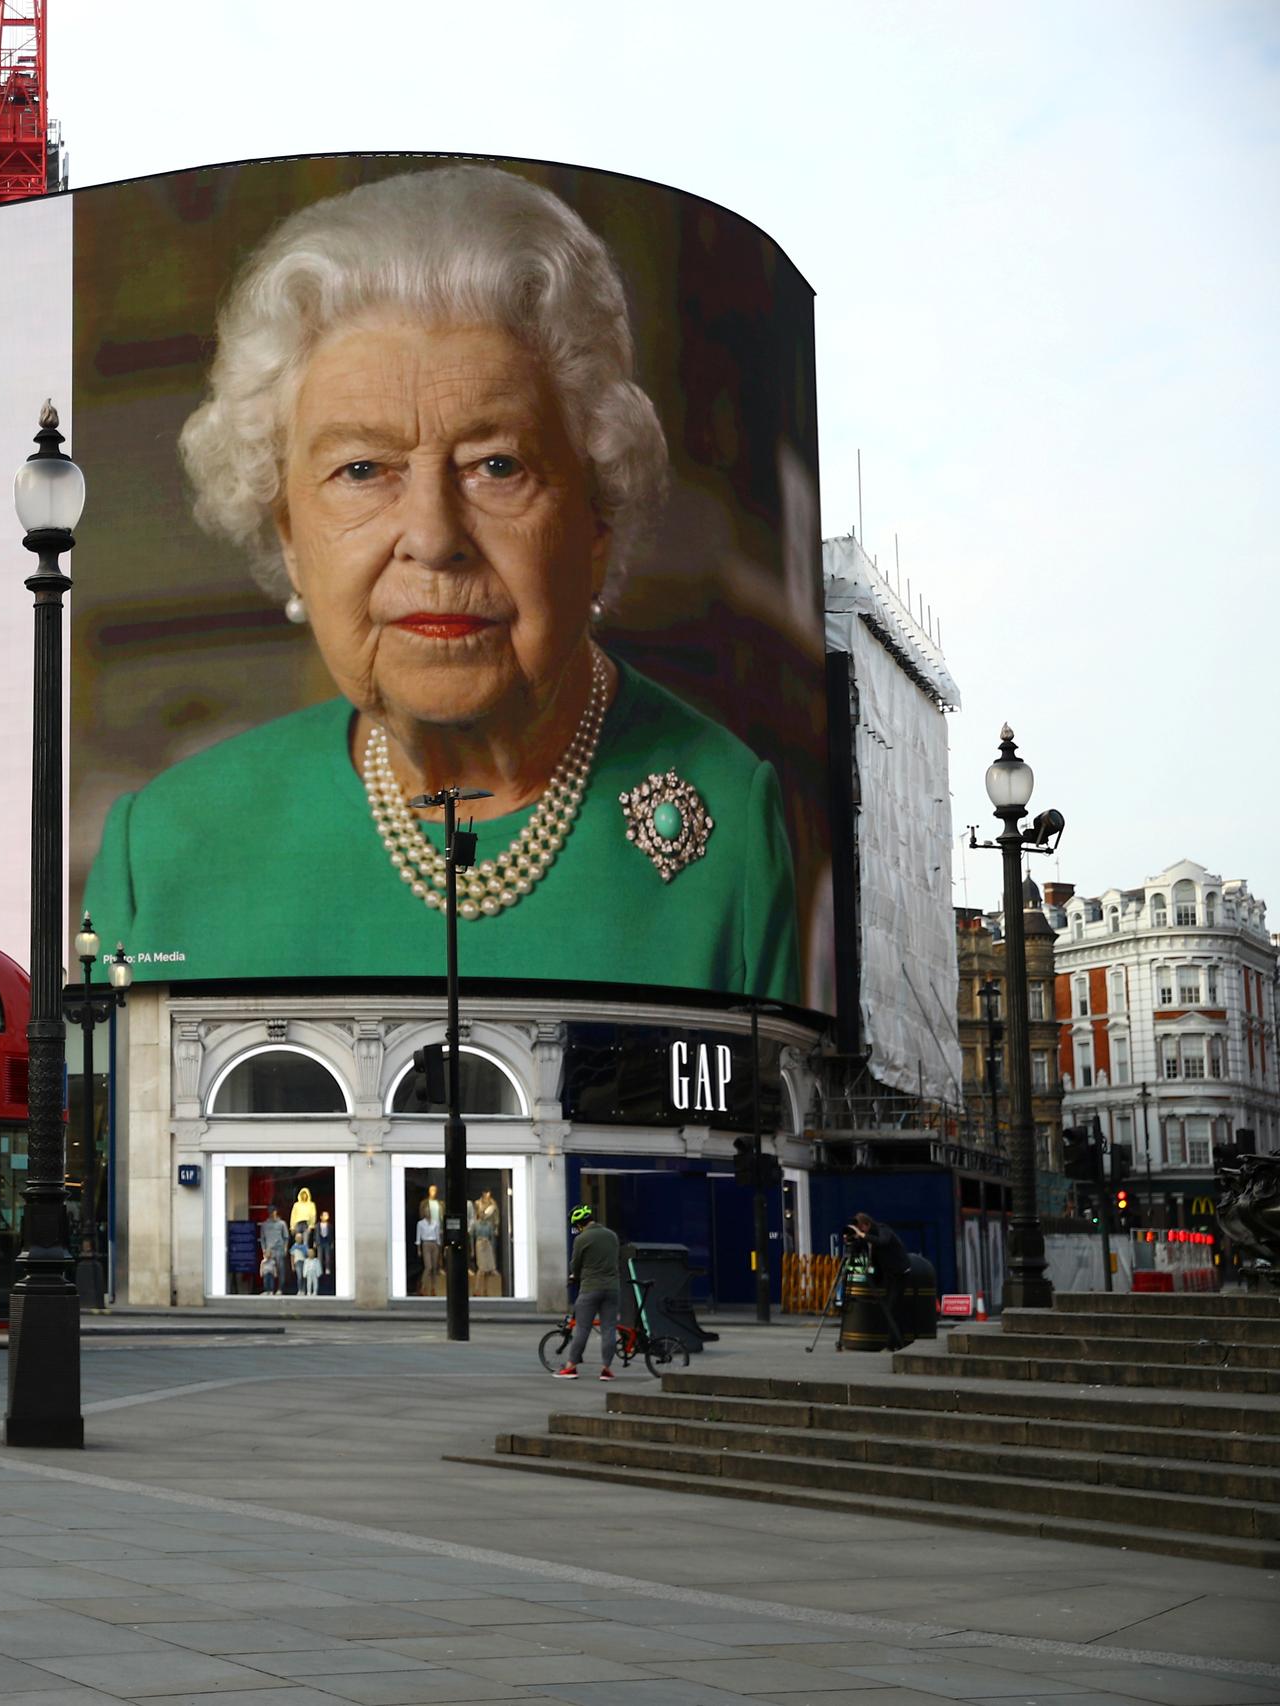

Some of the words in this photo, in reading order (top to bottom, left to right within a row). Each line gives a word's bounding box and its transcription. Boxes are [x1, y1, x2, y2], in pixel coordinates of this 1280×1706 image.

[138, 953, 152, 963] PA
[153, 951, 186, 962] Media
[672, 1040, 732, 1112] GAP
